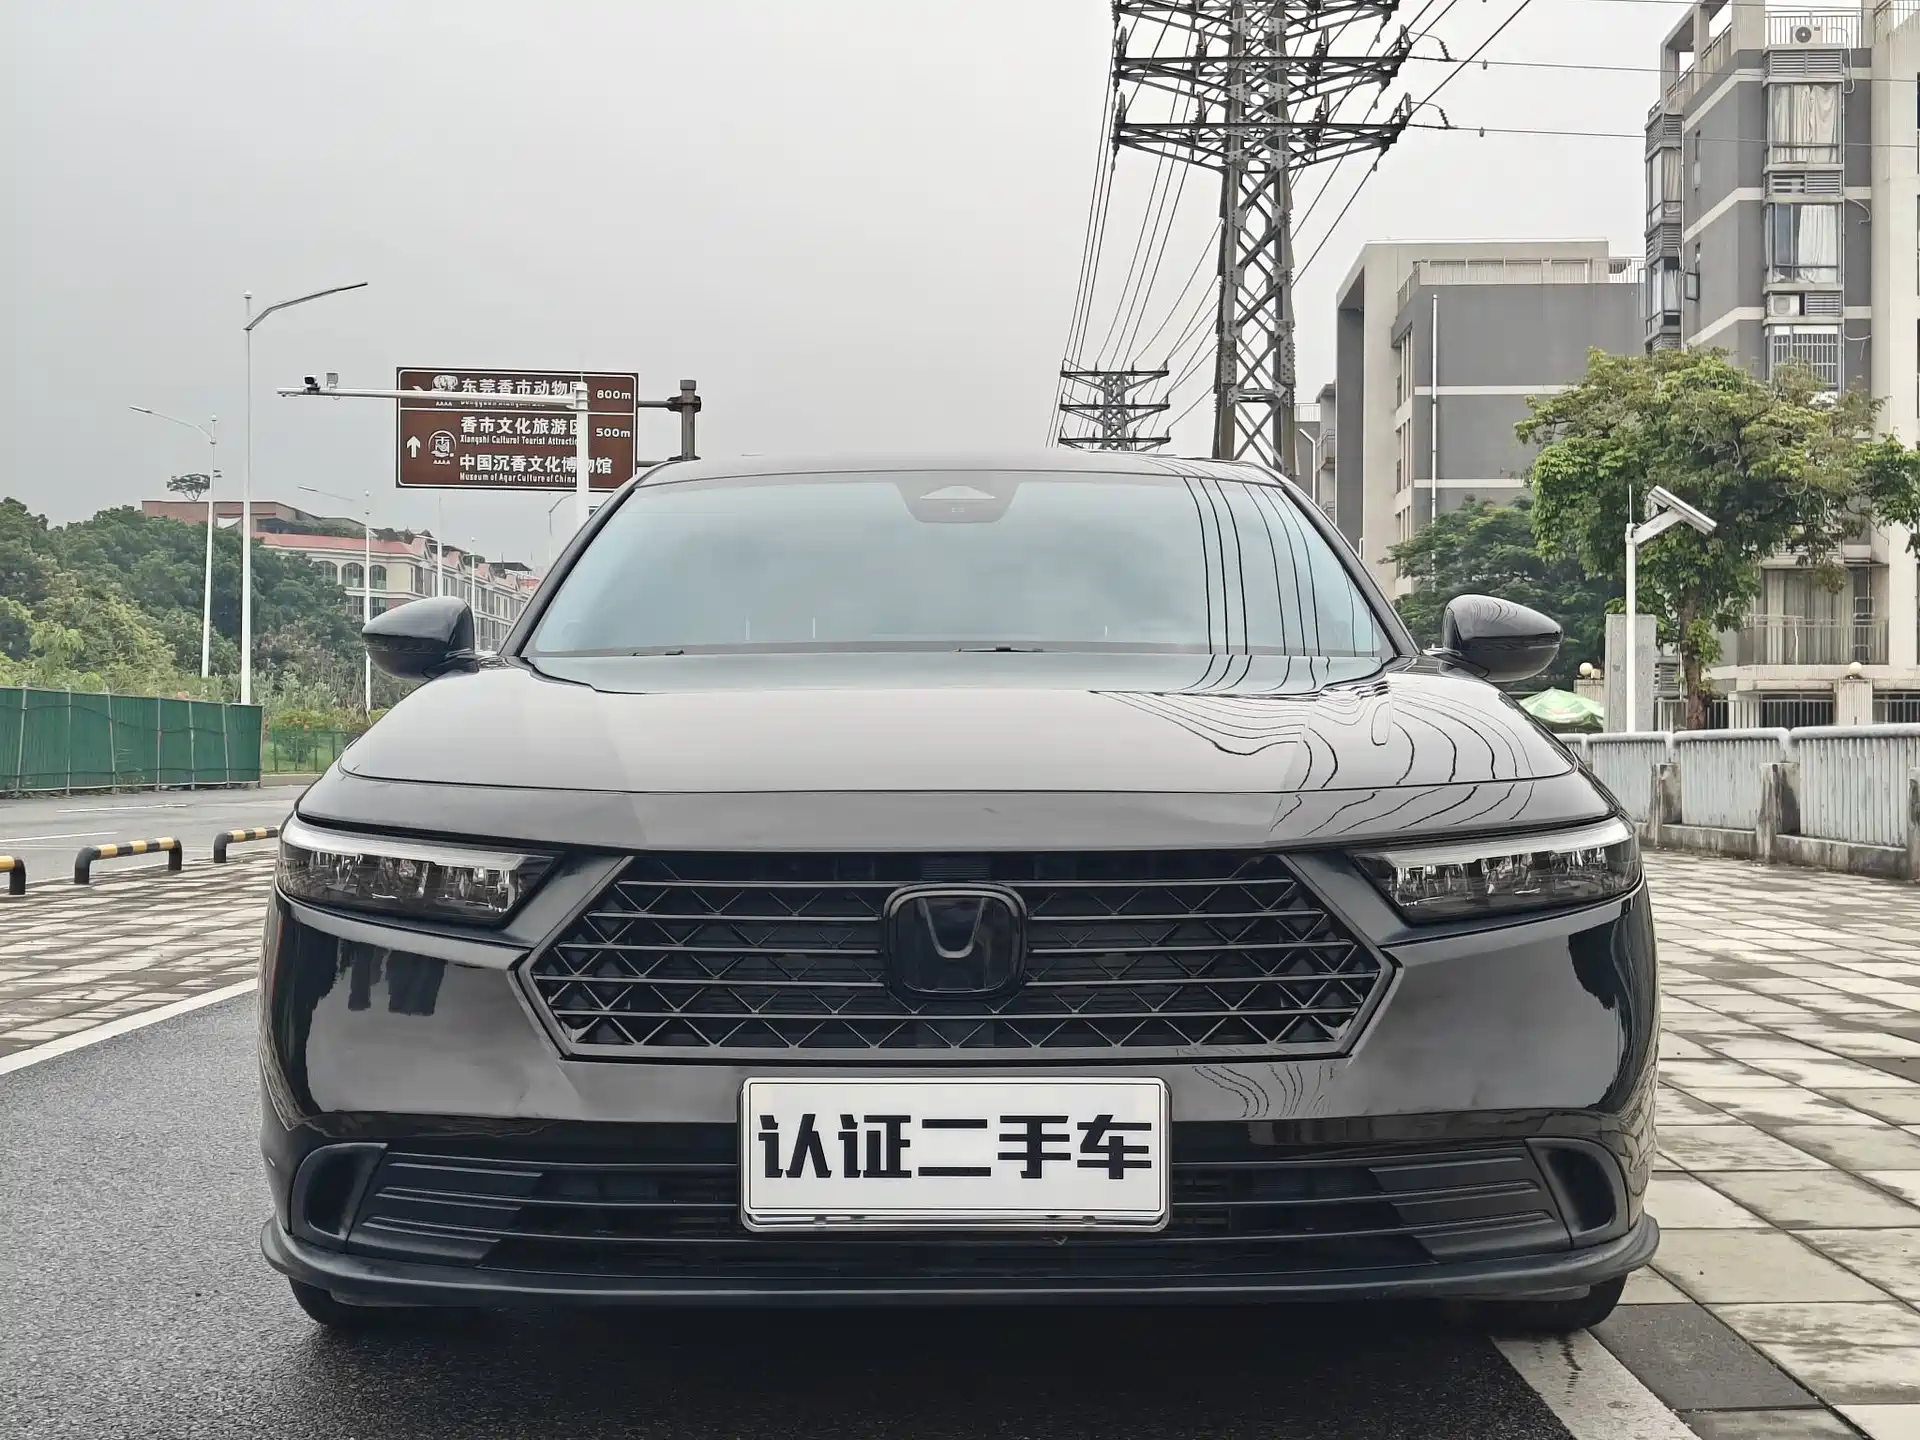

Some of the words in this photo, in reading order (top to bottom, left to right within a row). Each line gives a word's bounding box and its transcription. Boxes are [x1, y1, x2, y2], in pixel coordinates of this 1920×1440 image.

[596, 389, 631, 400] 800m
[595, 427, 631, 438] 500m
[492, 435, 520, 444] Cultural
[521, 436, 546, 445] Tourist
[459, 472, 489, 481] Museum
[490, 473, 498, 482] of
[517, 474, 545, 482] Culture
[546, 475, 554, 483] of
[554, 475, 576, 484] China
[758, 1113, 1152, 1180] 认证二手车
